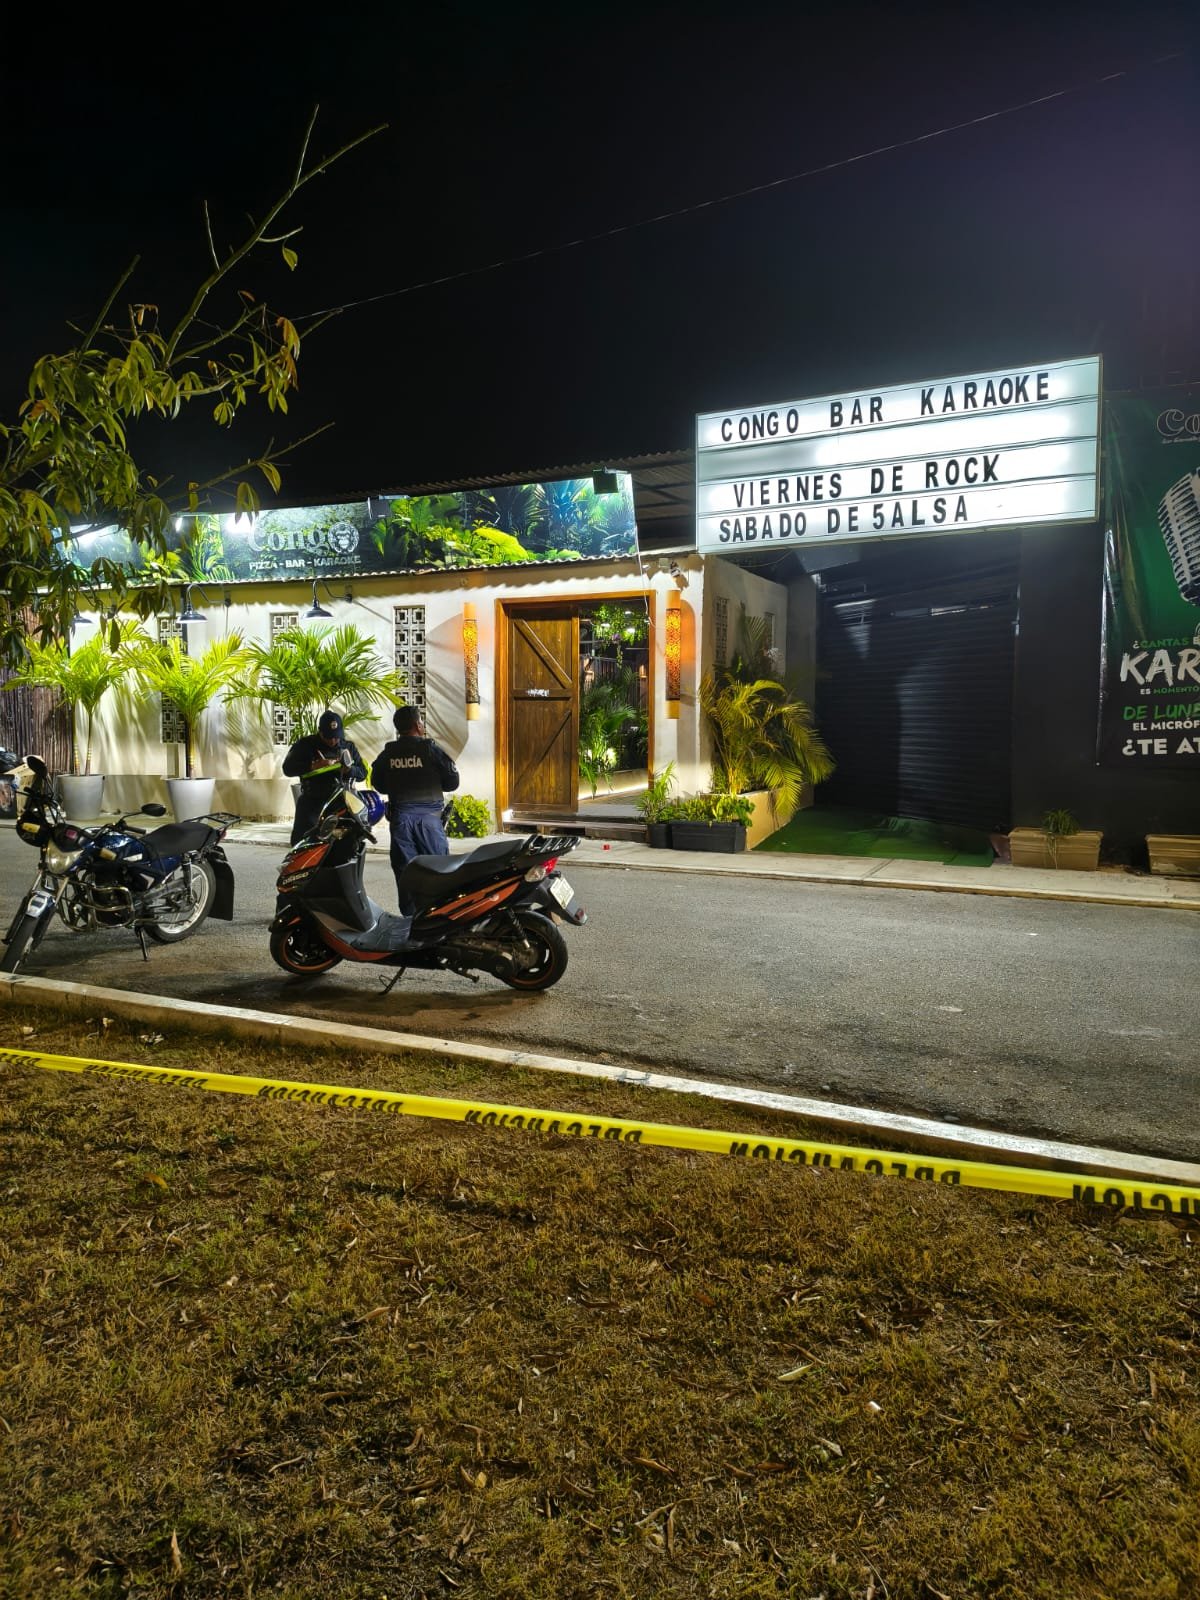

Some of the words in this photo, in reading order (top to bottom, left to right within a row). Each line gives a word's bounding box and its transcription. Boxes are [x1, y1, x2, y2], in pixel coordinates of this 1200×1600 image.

[720, 408, 800, 442] CONGO
[830, 397, 884, 427] BAR
[920, 372, 1050, 416] KARAOKE
[733, 473, 842, 508] VIERNES
[870, 465, 904, 494] DE
[925, 454, 1000, 488] ROCK
[719, 511, 808, 543] SABADO
[249, 559, 278, 570] PIZZA
[285, 559, 306, 568] BAR
[313, 555, 362, 567] KARAOKE
[1124, 706, 1147, 720] DE
[1133, 722, 1147, 731] EL
[1122, 738, 1168, 756] ¿TE
[390, 755, 423, 769] POLICÍA
